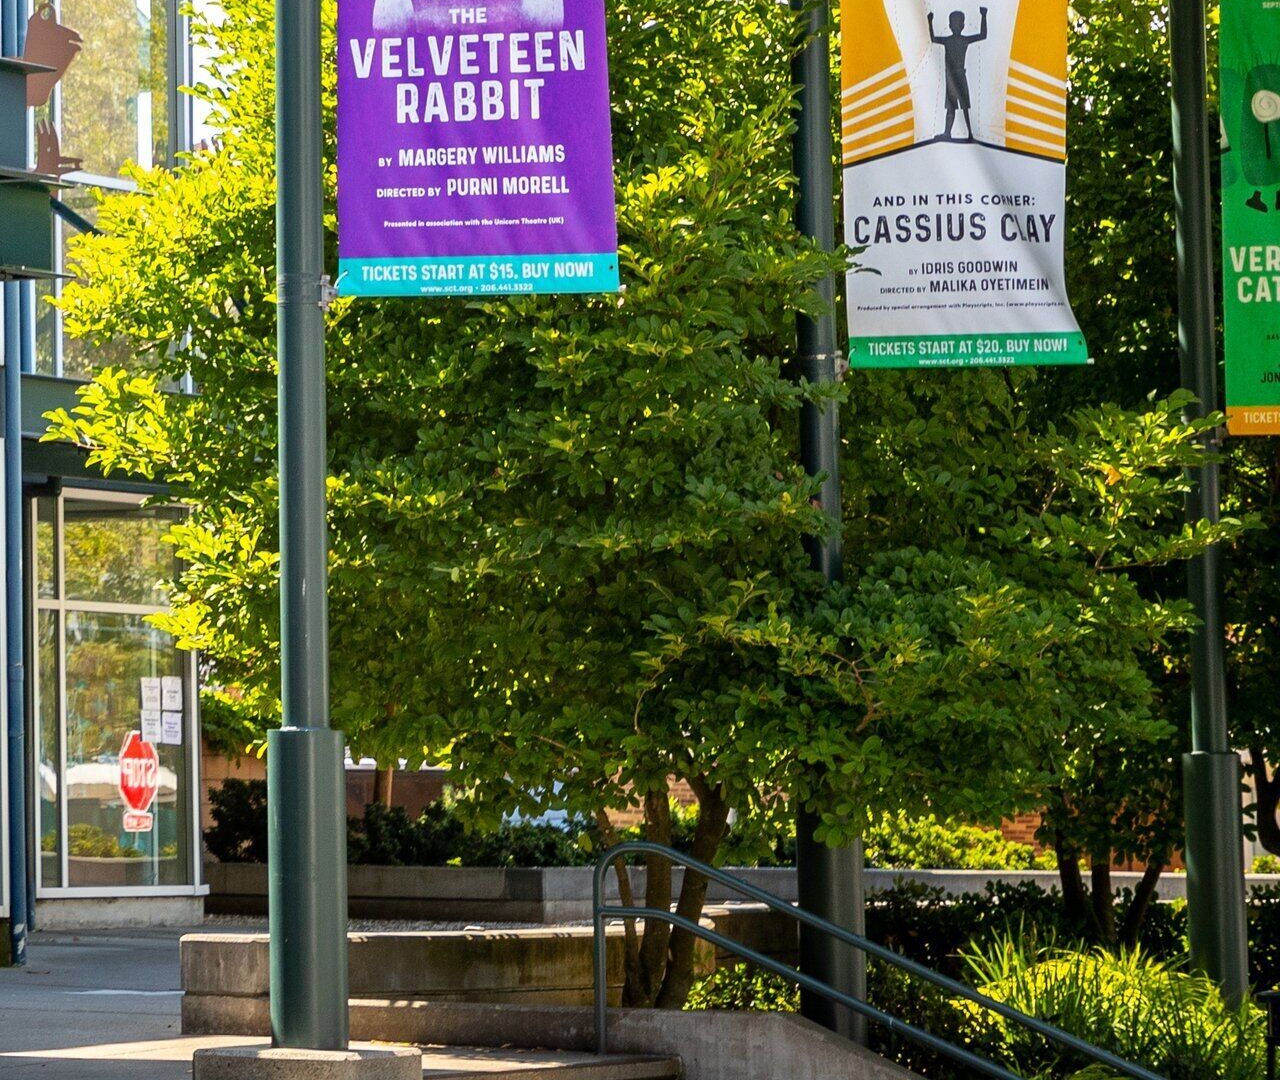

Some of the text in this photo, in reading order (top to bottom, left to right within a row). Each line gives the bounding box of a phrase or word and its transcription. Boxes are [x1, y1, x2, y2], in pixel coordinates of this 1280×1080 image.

[449, 7, 487, 24] THE
[350, 29, 585, 78] VELVETEEN
[396, 78, 545, 124] RABBIT
[378, 144, 565, 168] BY MARGERY WILLIAMS
[376, 176, 569, 198] DIRECTED BY PURNI MORELL
[873, 193, 1035, 207] AND IN THIS CORNER:
[549, 217, 564, 225] (UK)
[854, 212, 1056, 245] CASSIUS CLAY
[921, 262, 954, 274] IDRIS
[958, 260, 1018, 274] GOODWIN
[1229, 245, 1280, 273] VER
[362, 265, 417, 281] TICKETS
[421, 264, 465, 280] START
[469, 263, 485, 279] AT
[522, 262, 548, 278] BUY
[554, 261, 594, 278] NOW!
[420, 285, 473, 293] www.sct.org
[917, 286, 926, 294] BY
[930, 280, 977, 293] MALIKA
[981, 278, 1049, 291] OYETIMEIN
[868, 342, 915, 356] TICKETS
[919, 341, 956, 354] START
[959, 340, 972, 353] AT
[1006, 339, 1029, 353] BUY
[1034, 338, 1068, 352] NOW!
